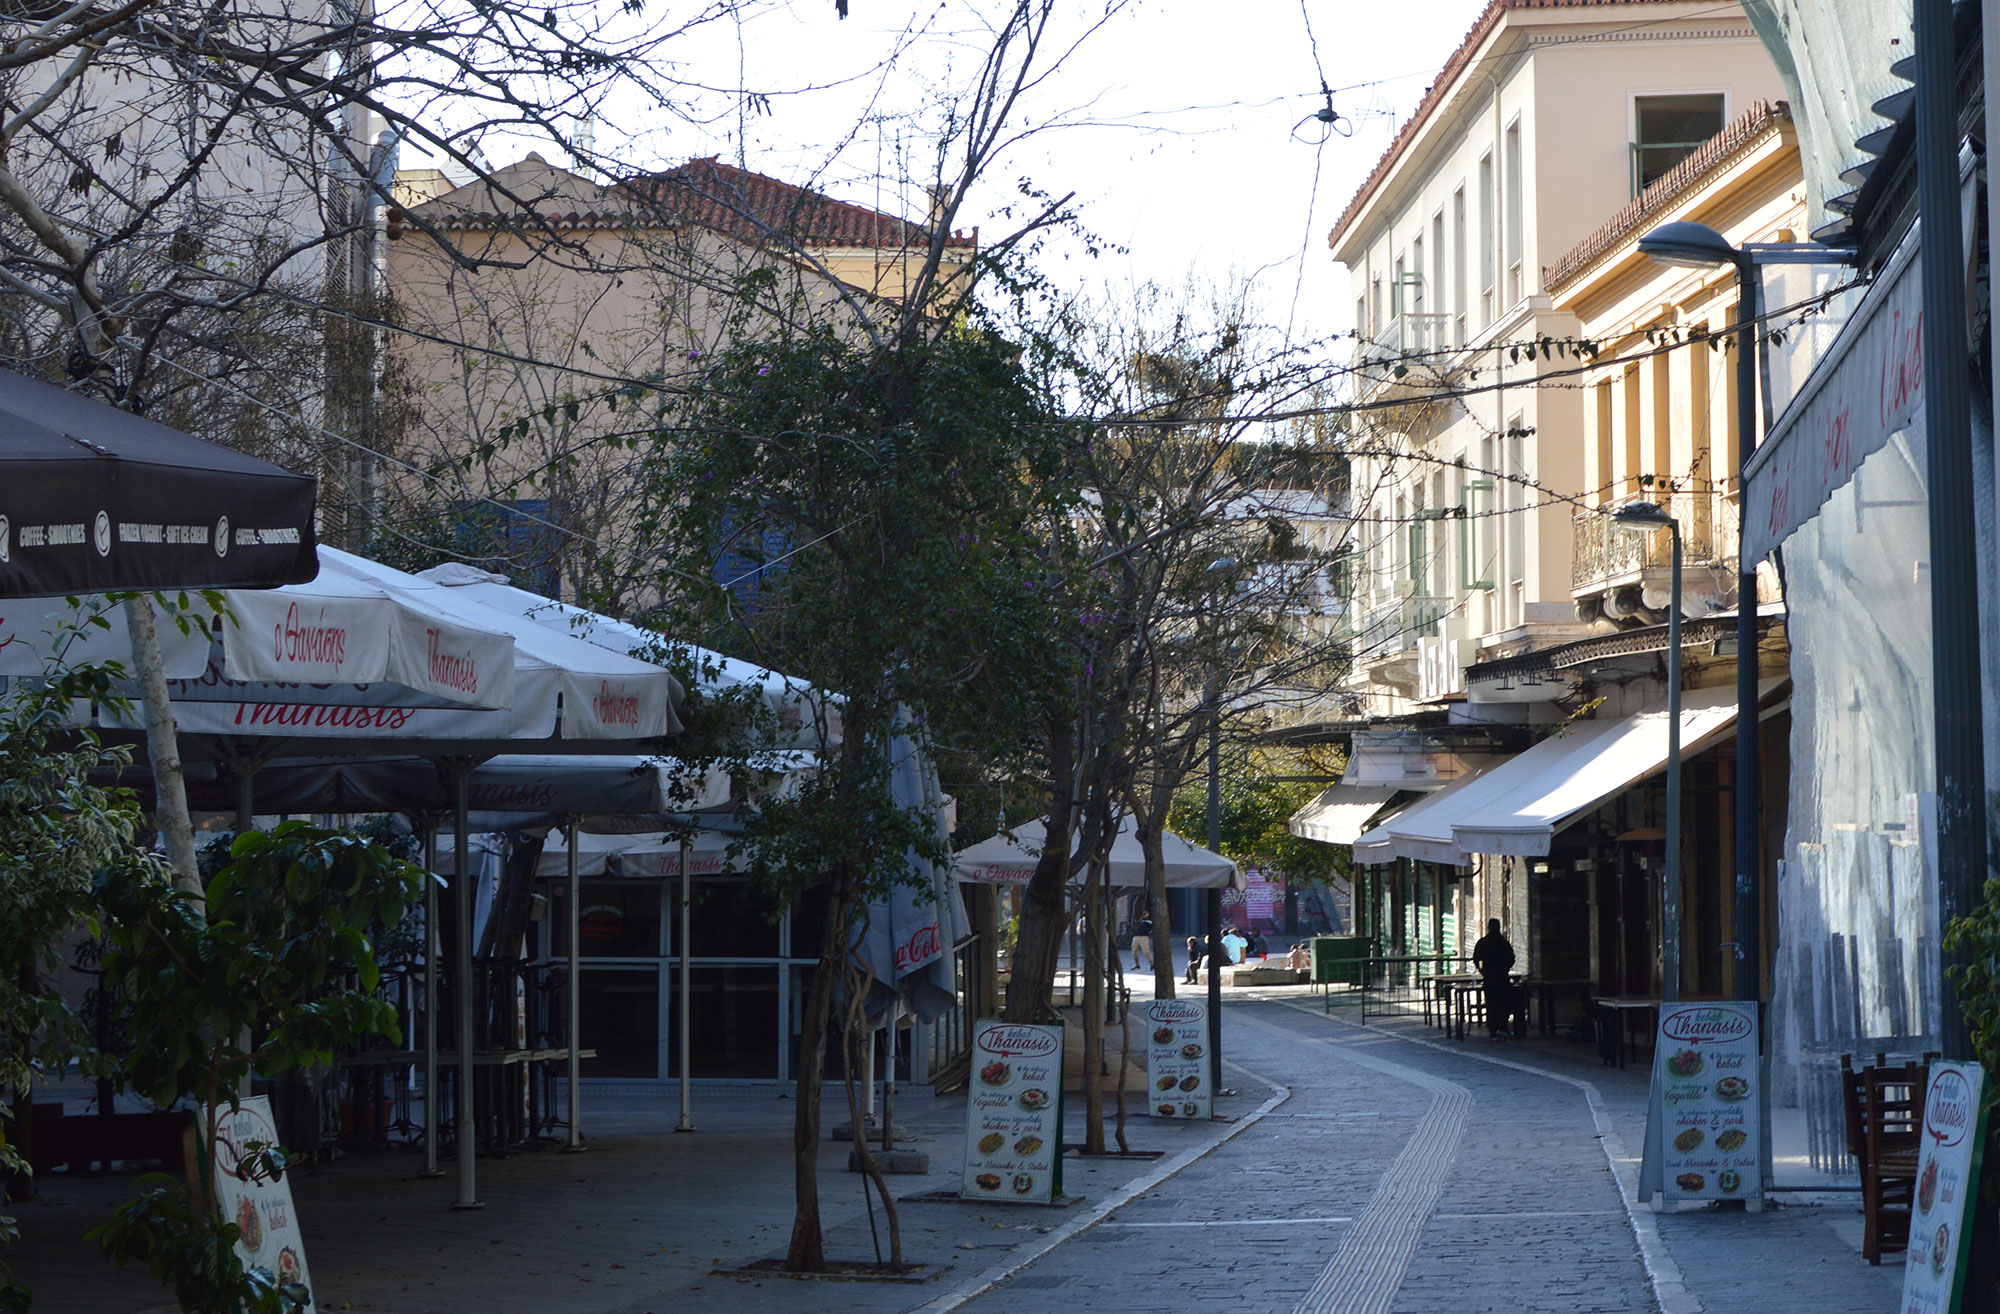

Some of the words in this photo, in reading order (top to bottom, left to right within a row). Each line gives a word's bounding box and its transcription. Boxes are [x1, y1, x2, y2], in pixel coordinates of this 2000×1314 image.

[285, 601, 345, 673] Θανάσης
[427, 628, 478, 694] Thanasis
[469, 778, 557, 806] anasis
[1155, 1005, 1201, 1018] Thanasis
[1695, 1010, 1724, 1022] kebab
[1007, 1027, 1033, 1038] kebab
[1673, 1016, 1747, 1035] Thanasis
[987, 1030, 1052, 1050] Thanasis
[1716, 1058, 1743, 1069] kebab
[1021, 1070, 1046, 1081] kebab
[1931, 1084, 1968, 1129] Thanasis
[981, 1121, 1009, 1131] chicken
[1021, 1123, 1042, 1135] pork
[1676, 1115, 1707, 1126] chicken
[1722, 1115, 1744, 1128] pork
